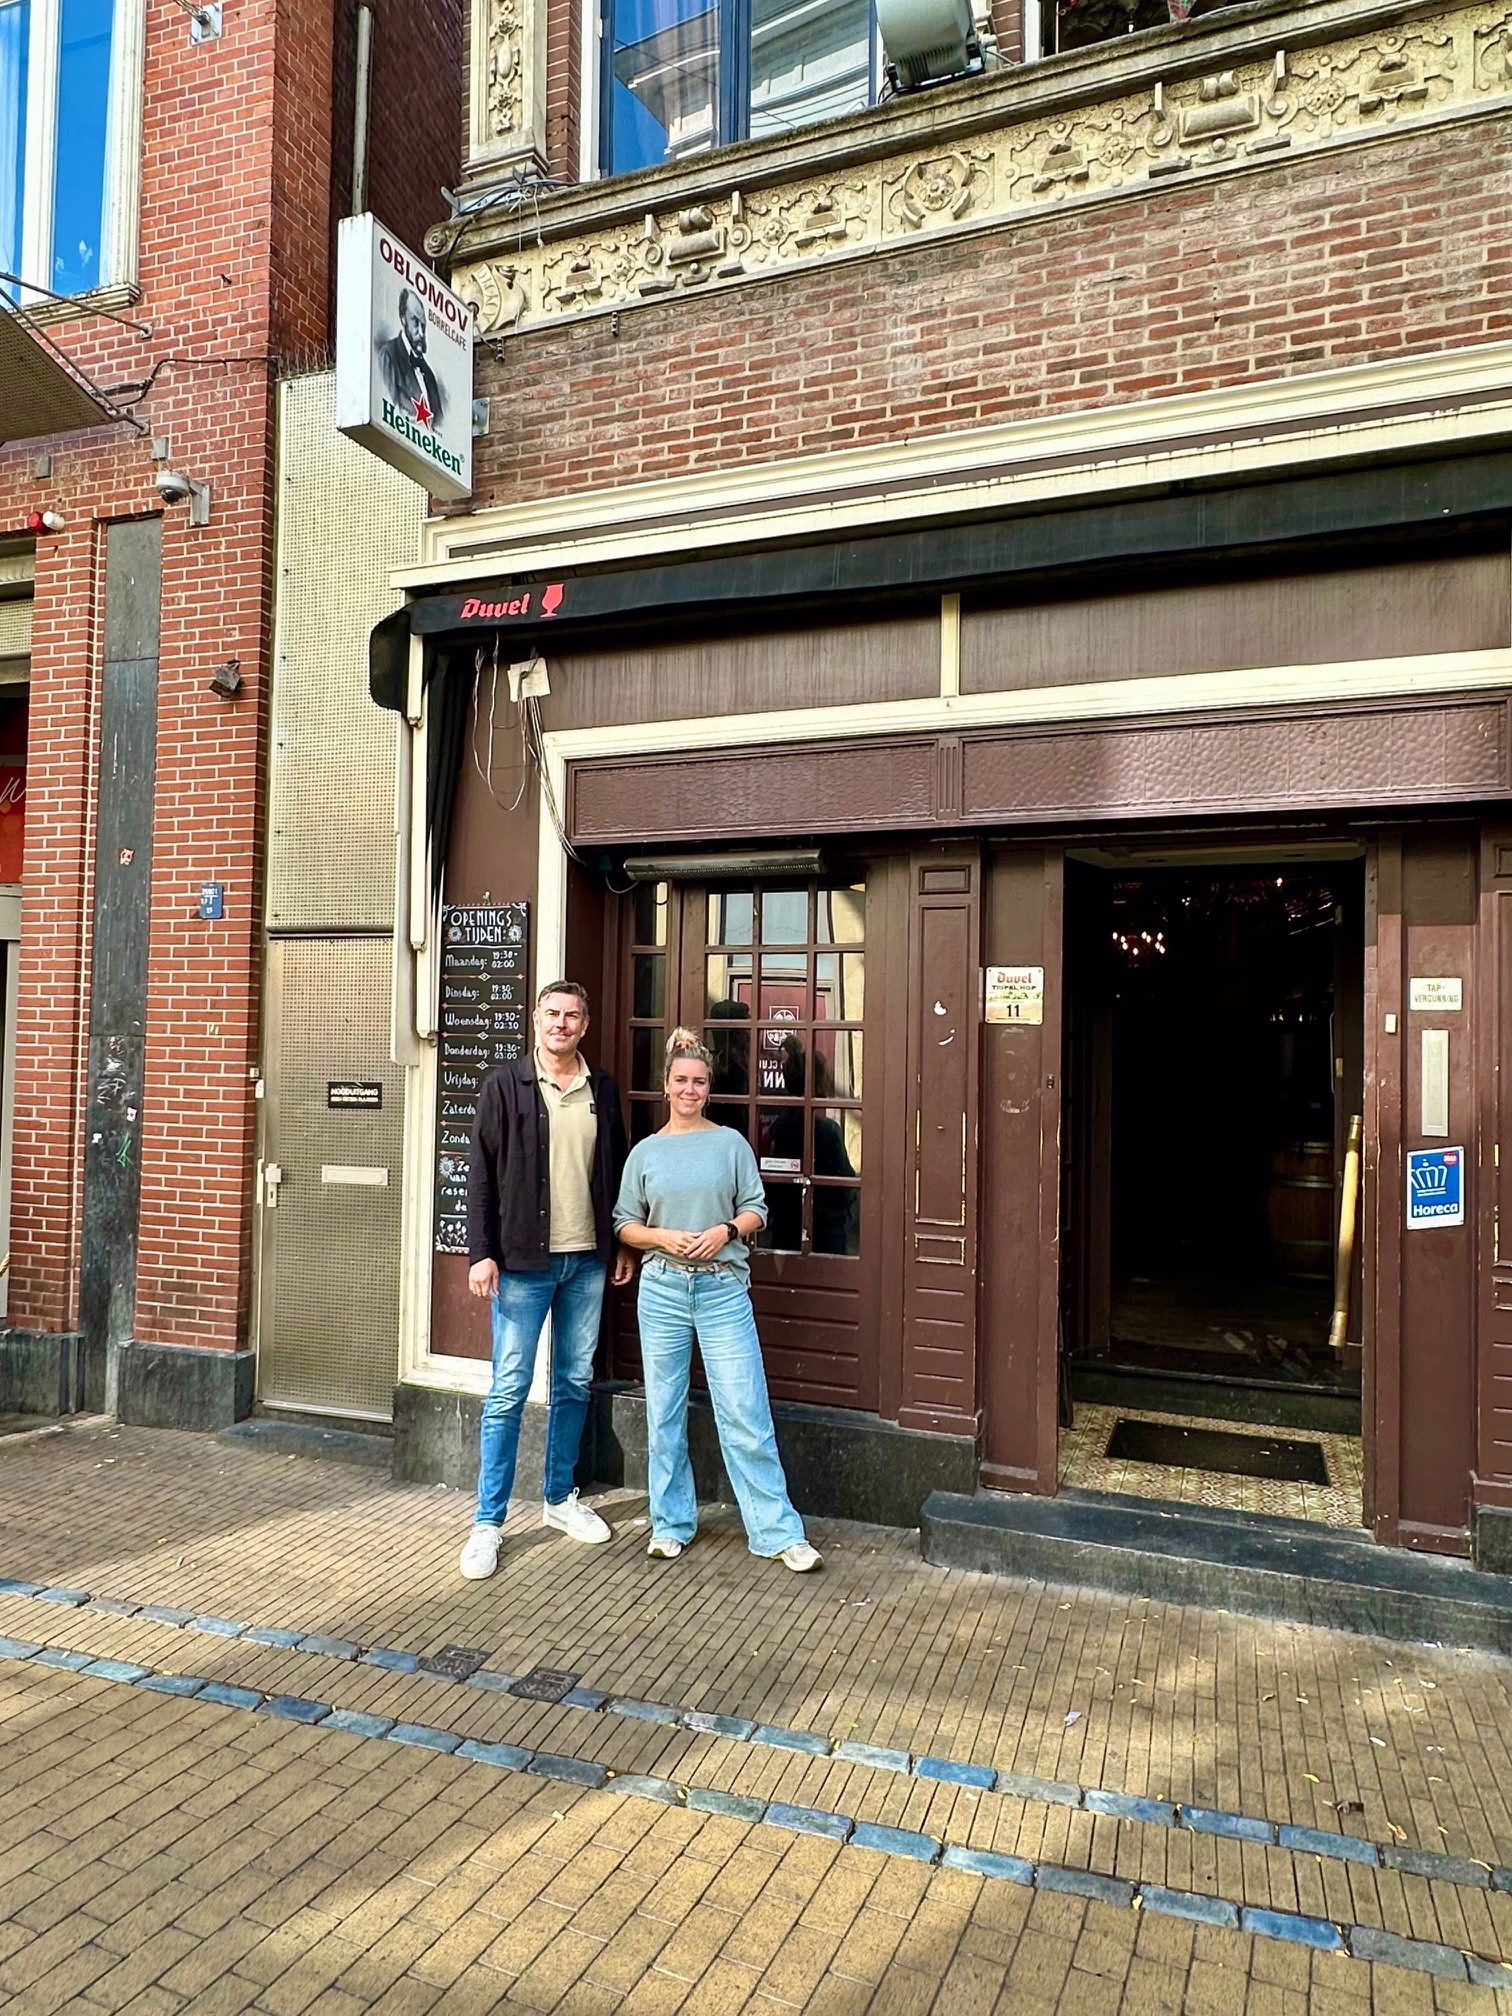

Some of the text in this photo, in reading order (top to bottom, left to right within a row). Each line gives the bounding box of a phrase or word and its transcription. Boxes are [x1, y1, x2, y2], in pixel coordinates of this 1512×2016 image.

[380, 238, 468, 331] OBLOMOV
[382, 398, 462, 475] Heineken
[461, 593, 531, 618] Duvel
[451, 910, 512, 927] OPENINGS
[465, 926, 507, 944] TIJDEN:
[445, 954, 488, 970] Maandag:
[997, 971, 1032, 984] Duvel
[445, 985, 480, 1001] Dinsdag:
[1006, 1004, 1020, 1017] 11
[445, 1013, 492, 1030] Woensdag:
[494, 1021, 519, 1030] 02:30
[444, 1043, 491, 1059] Donderdag:
[444, 1071, 479, 1089] Vrijdag:
[442, 1101, 477, 1115] Zaterda
[441, 1131, 471, 1144] Zonda
[1413, 1202, 1459, 1217] Horeca
